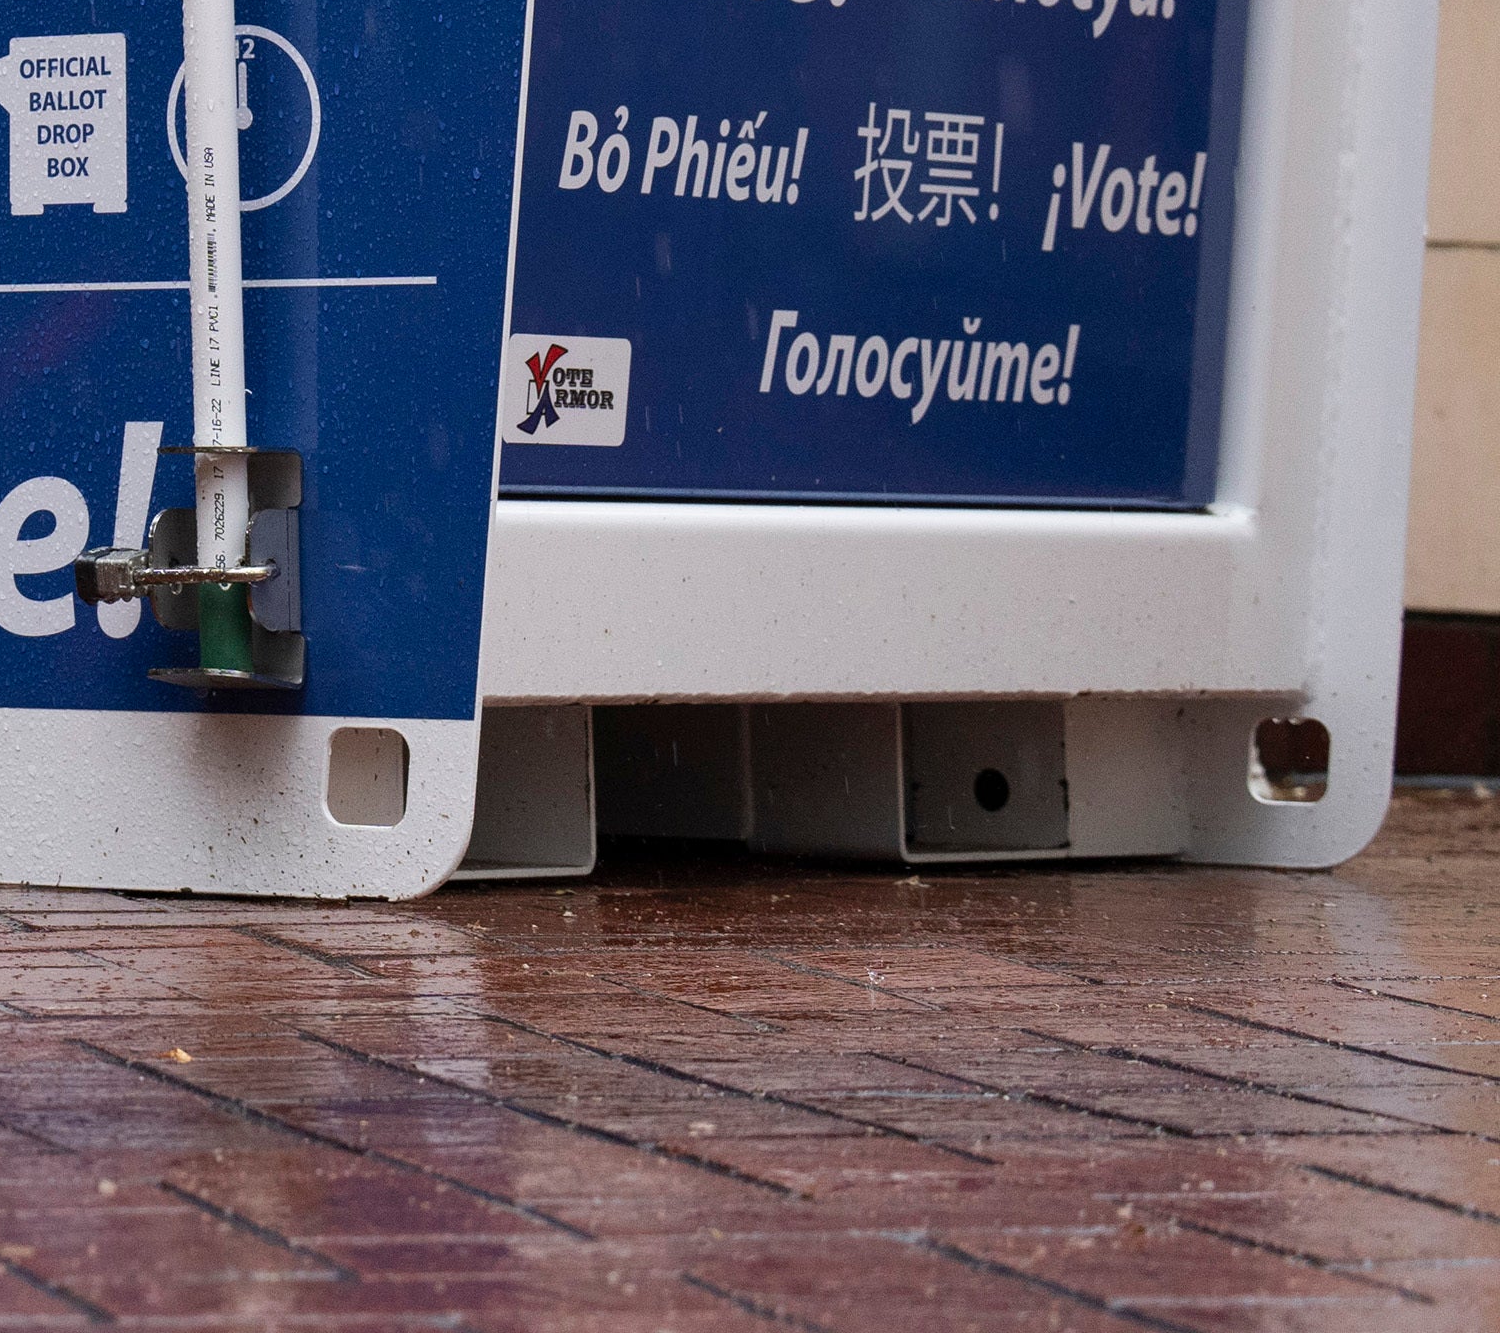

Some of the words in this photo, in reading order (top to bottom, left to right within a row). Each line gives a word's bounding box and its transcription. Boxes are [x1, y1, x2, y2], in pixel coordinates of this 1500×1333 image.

[19, 55, 112, 79] OFFICIAL
[29, 89, 107, 112] BALLOT
[37, 123, 95, 145] DROP
[47, 156, 90, 178] BOX
[204, 147, 214, 168] USA
[559, 105, 630, 194] Bỏ
[641, 109, 809, 206] Phiếu!
[204, 174, 215, 187] IN
[205, 194, 216, 223] MADE
[1041, 141, 1207, 252] ¡Vote!
[208, 305, 220, 332] PVC1
[209, 338, 220, 351] 17
[210, 357, 221, 386] LINE
[525, 343, 593, 400] VOTE
[759, 308, 1081, 424] Голосуйте!
[211, 398, 222, 447] 7-16-22
[213, 466, 224, 480] 17
